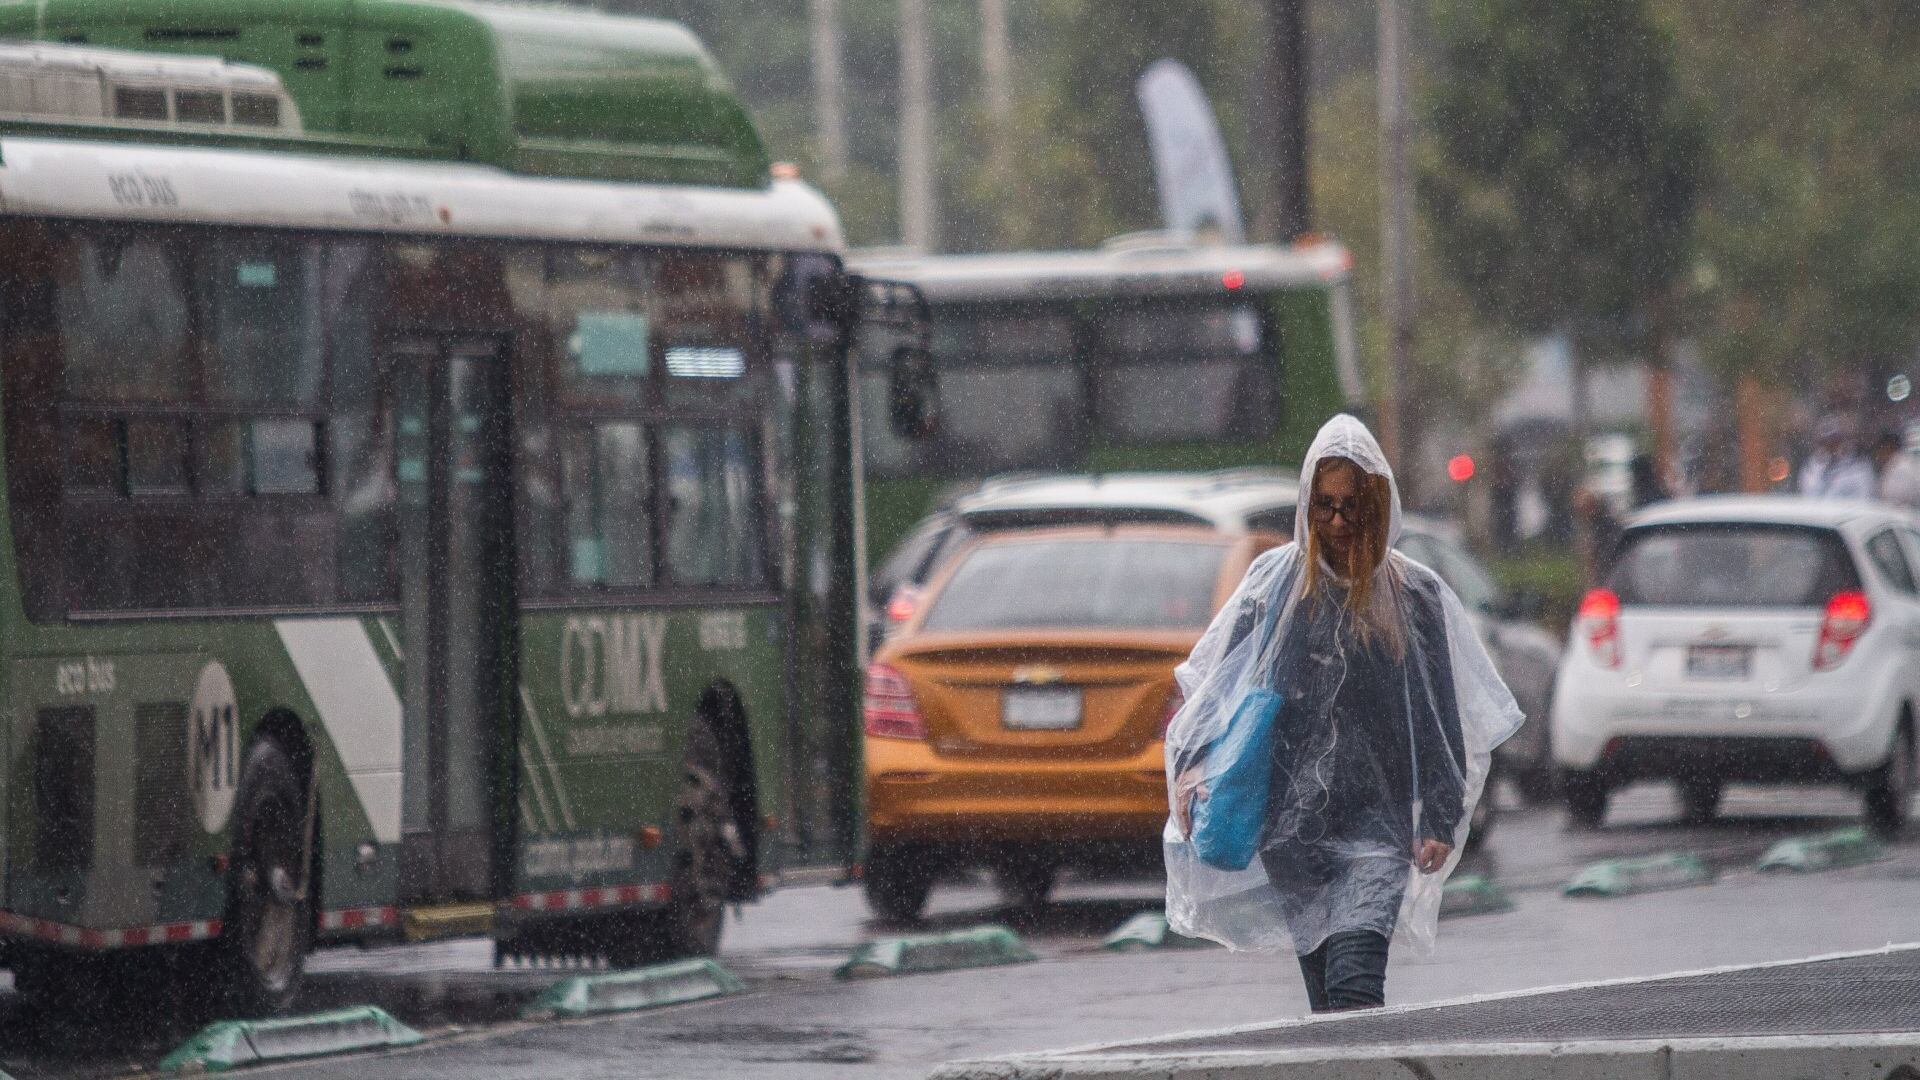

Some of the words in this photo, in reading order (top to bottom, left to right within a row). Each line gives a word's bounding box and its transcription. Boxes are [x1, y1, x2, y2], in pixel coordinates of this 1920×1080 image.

[57, 662, 86, 694] eco
[87, 655, 116, 691] bus
[560, 612, 668, 717] CDMX
[193, 703, 234, 791] M1
